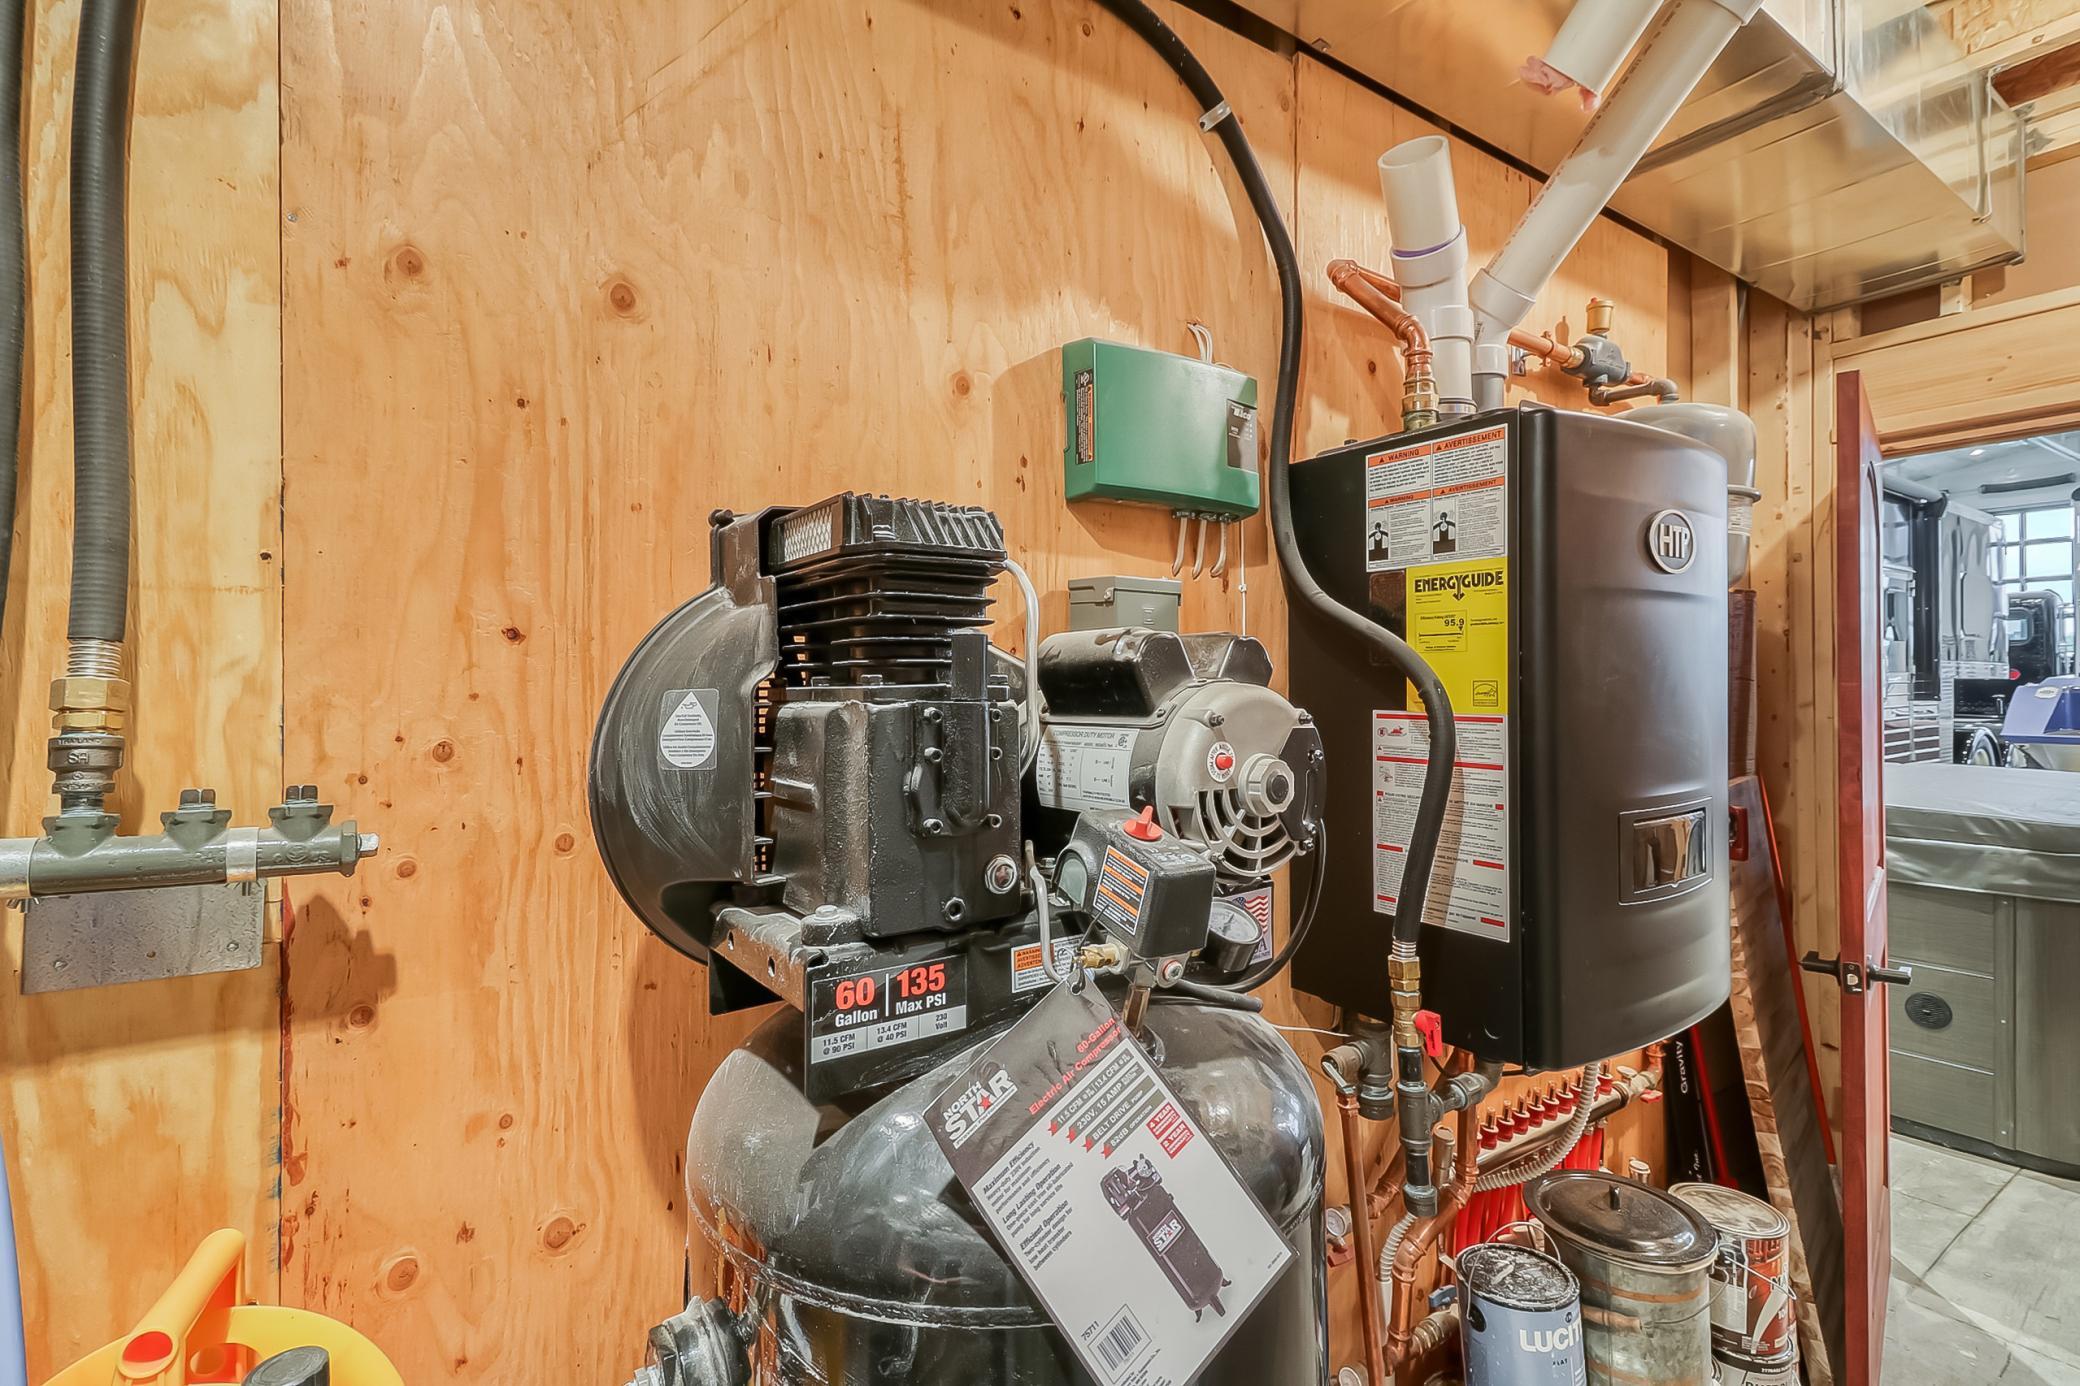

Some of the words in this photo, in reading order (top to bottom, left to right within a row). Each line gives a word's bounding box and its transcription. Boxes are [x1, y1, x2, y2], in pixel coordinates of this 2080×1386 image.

[1444, 430, 1502, 449] AVERTISSEMENT
[1388, 448, 1420, 461] WARNING
[1659, 524, 1690, 559] HTP
[1414, 571, 1504, 593] ENERGYGUIDE
[1444, 618, 1464, 626] 95.9
[896, 964, 946, 998] 135
[835, 976, 876, 1010] 60
[896, 1000, 922, 1015] Max
[926, 993, 946, 1008] PSI
[835, 1009, 878, 1028] Gallon
[877, 1025, 892, 1034] 13.4
[893, 1022, 908, 1032] CFM
[936, 1013, 948, 1022] 230
[936, 1021, 948, 1030] Volt
[823, 1036, 838, 1046] 11.5
[840, 1033, 856, 1043] CFM
[896, 1031, 907, 1040] PSI
[832, 1046, 841, 1054] 90
[842, 1043, 855, 1052] PSI
[1030, 1083, 1062, 1115] Electric
[1062, 1070, 1075, 1084] Air
[1076, 1026, 1122, 1071] Compressor
[1675, 1040, 1688, 1094] Gravity
[1069, 1099, 1083, 1112] CFM
[1107, 1064, 1119, 1076] CFM
[1107, 1084, 1123, 1099] AMP
[942, 1080, 982, 1120] NORTH
[945, 1069, 1015, 1140] STAR
[1093, 1123, 1110, 1140] BELT
[1110, 1103, 1130, 1123] DRIVE
[1155, 1105, 1171, 1121] YEAR
[1169, 1124, 1185, 1140] YEAR
[983, 1167, 1010, 1194] Maximum
[1009, 1142, 1035, 1168] Efficiency
[1003, 1209, 1017, 1224] Long
[1016, 1189, 1037, 1210] Lasting
[1036, 1164, 1061, 1190] Operation
[1020, 1225, 1044, 1250] Efficient
[1043, 1201, 1069, 1227] Operation
[1154, 1219, 1182, 1250] STAR
[1081, 1320, 1100, 1340] 75711
[1520, 1318, 1582, 1352] LUCIT
